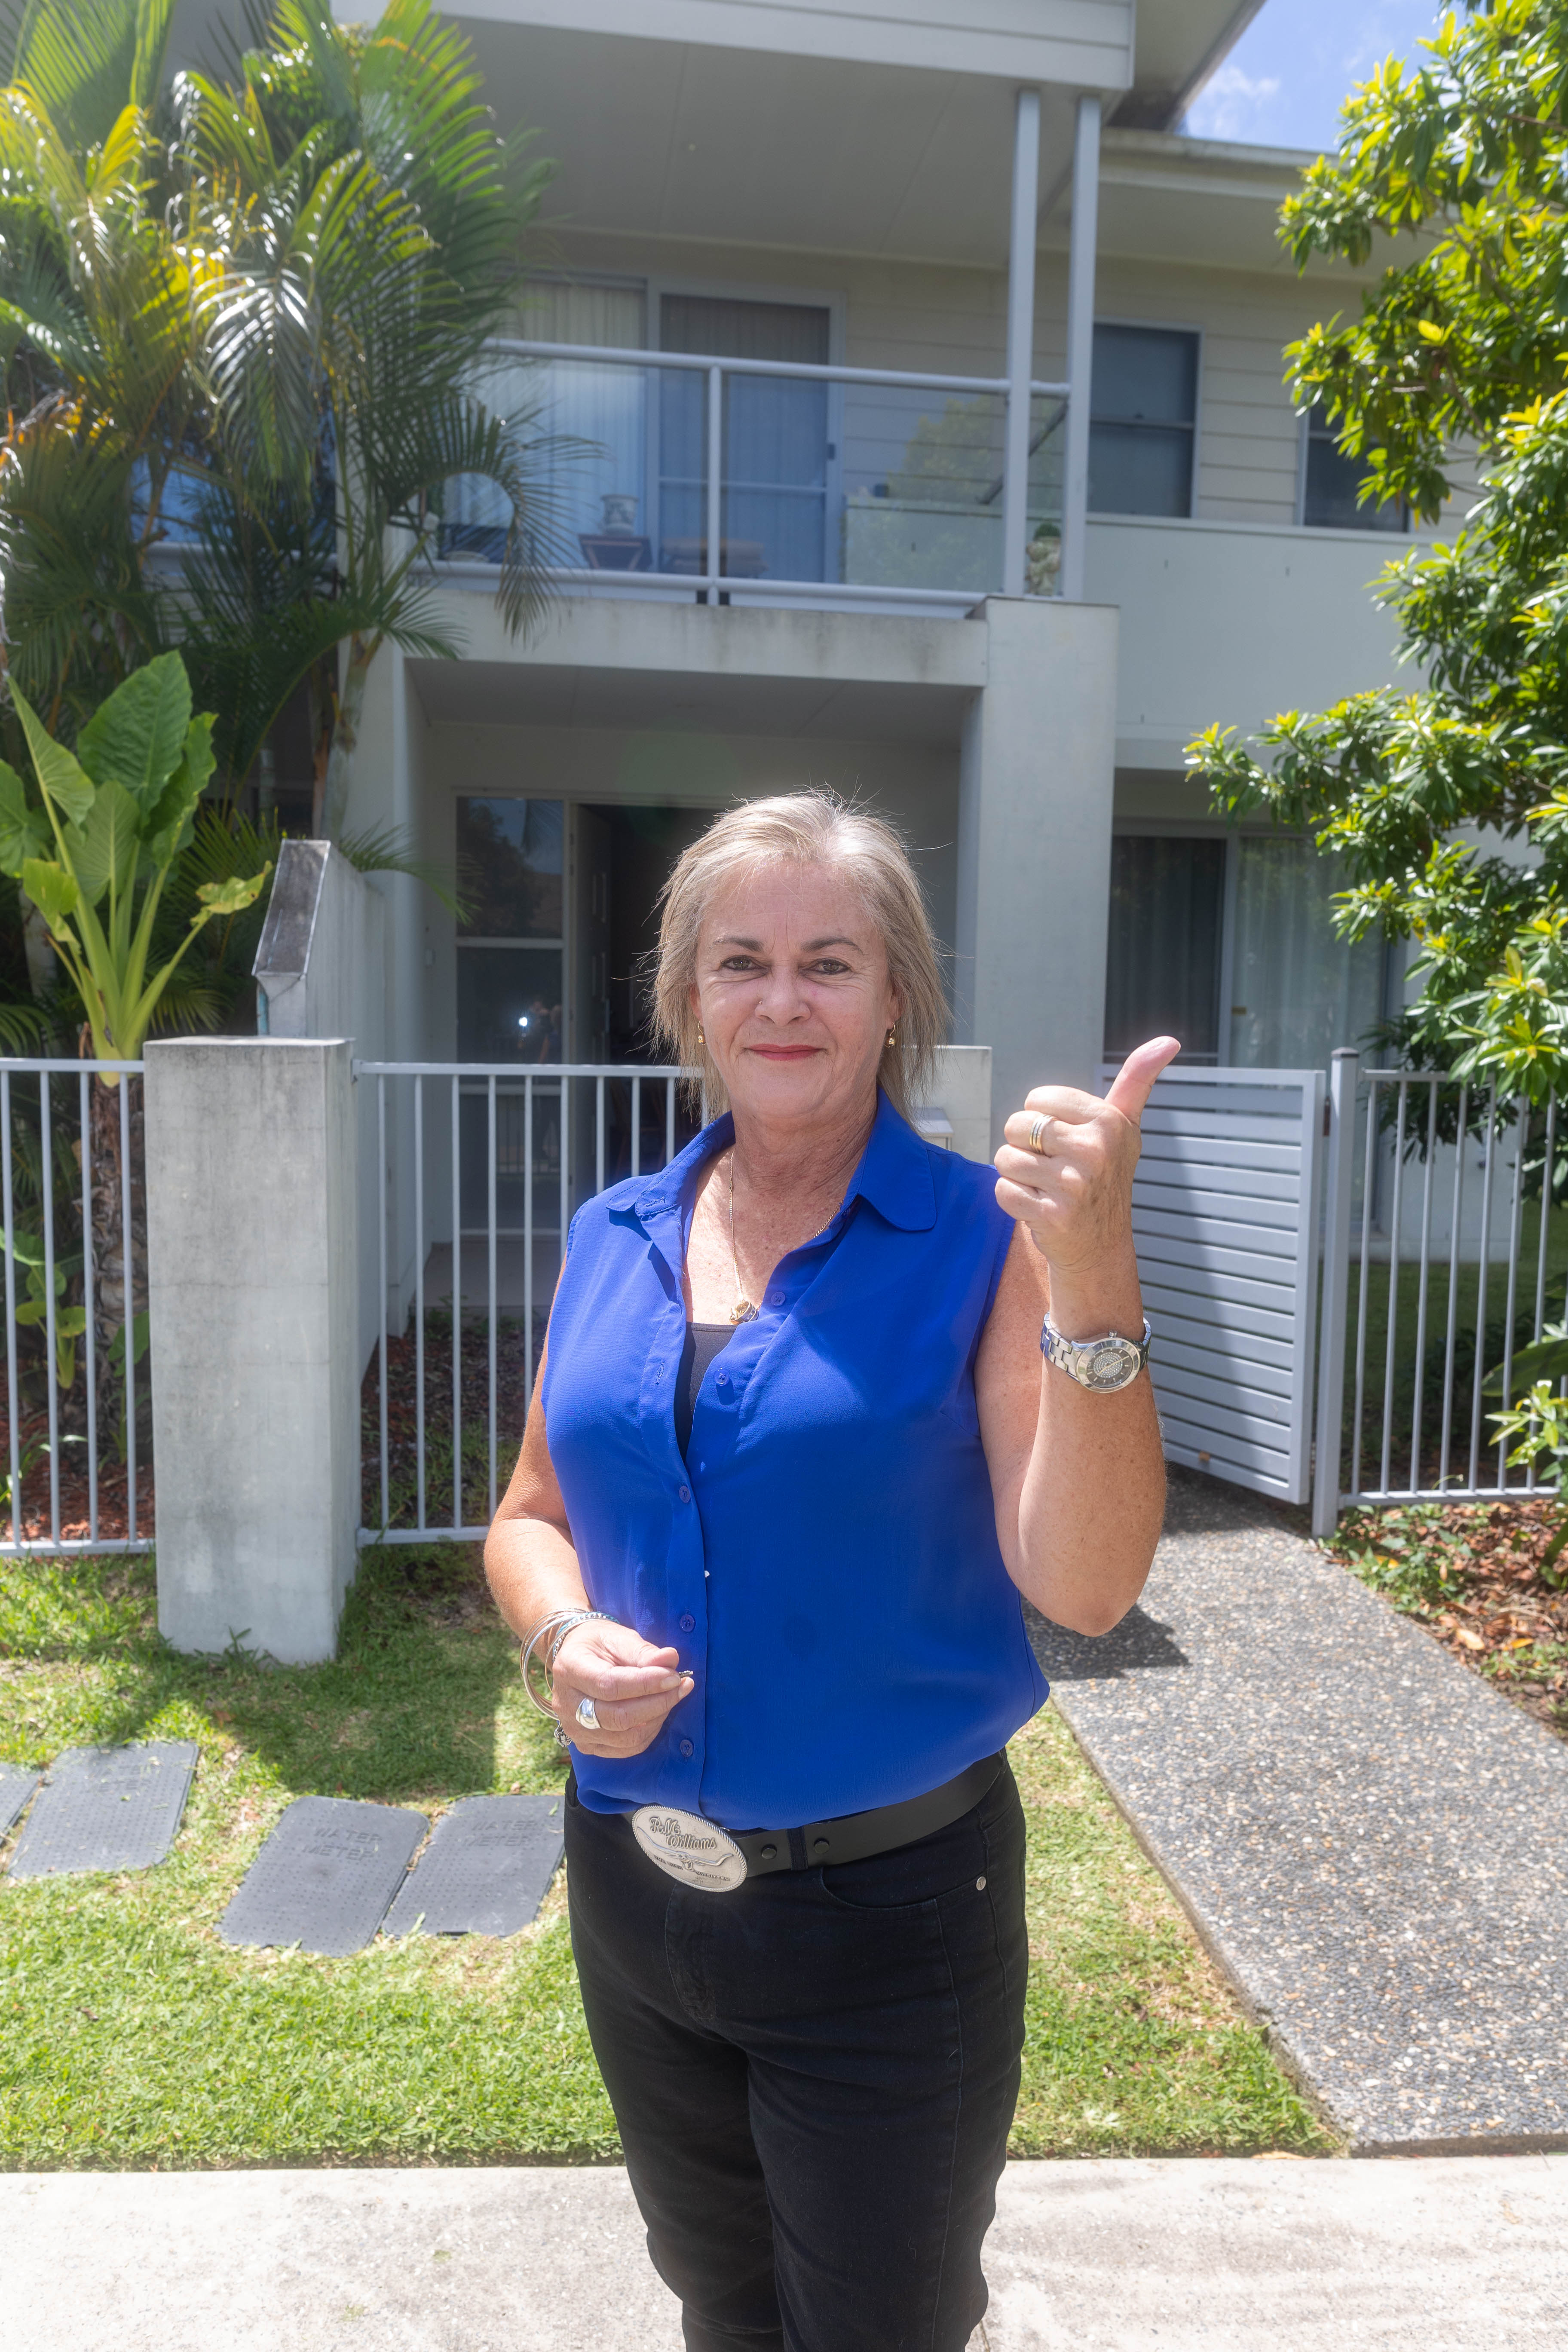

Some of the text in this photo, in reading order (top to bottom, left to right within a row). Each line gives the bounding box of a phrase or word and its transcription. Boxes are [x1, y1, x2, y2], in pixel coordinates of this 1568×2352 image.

[471, 1819, 537, 1831] WATER
[314, 1827, 383, 1844] WATER
[461, 1835, 530, 1847] METER
[665, 1834, 717, 1850] Williams
[302, 1844, 376, 1861] METER
